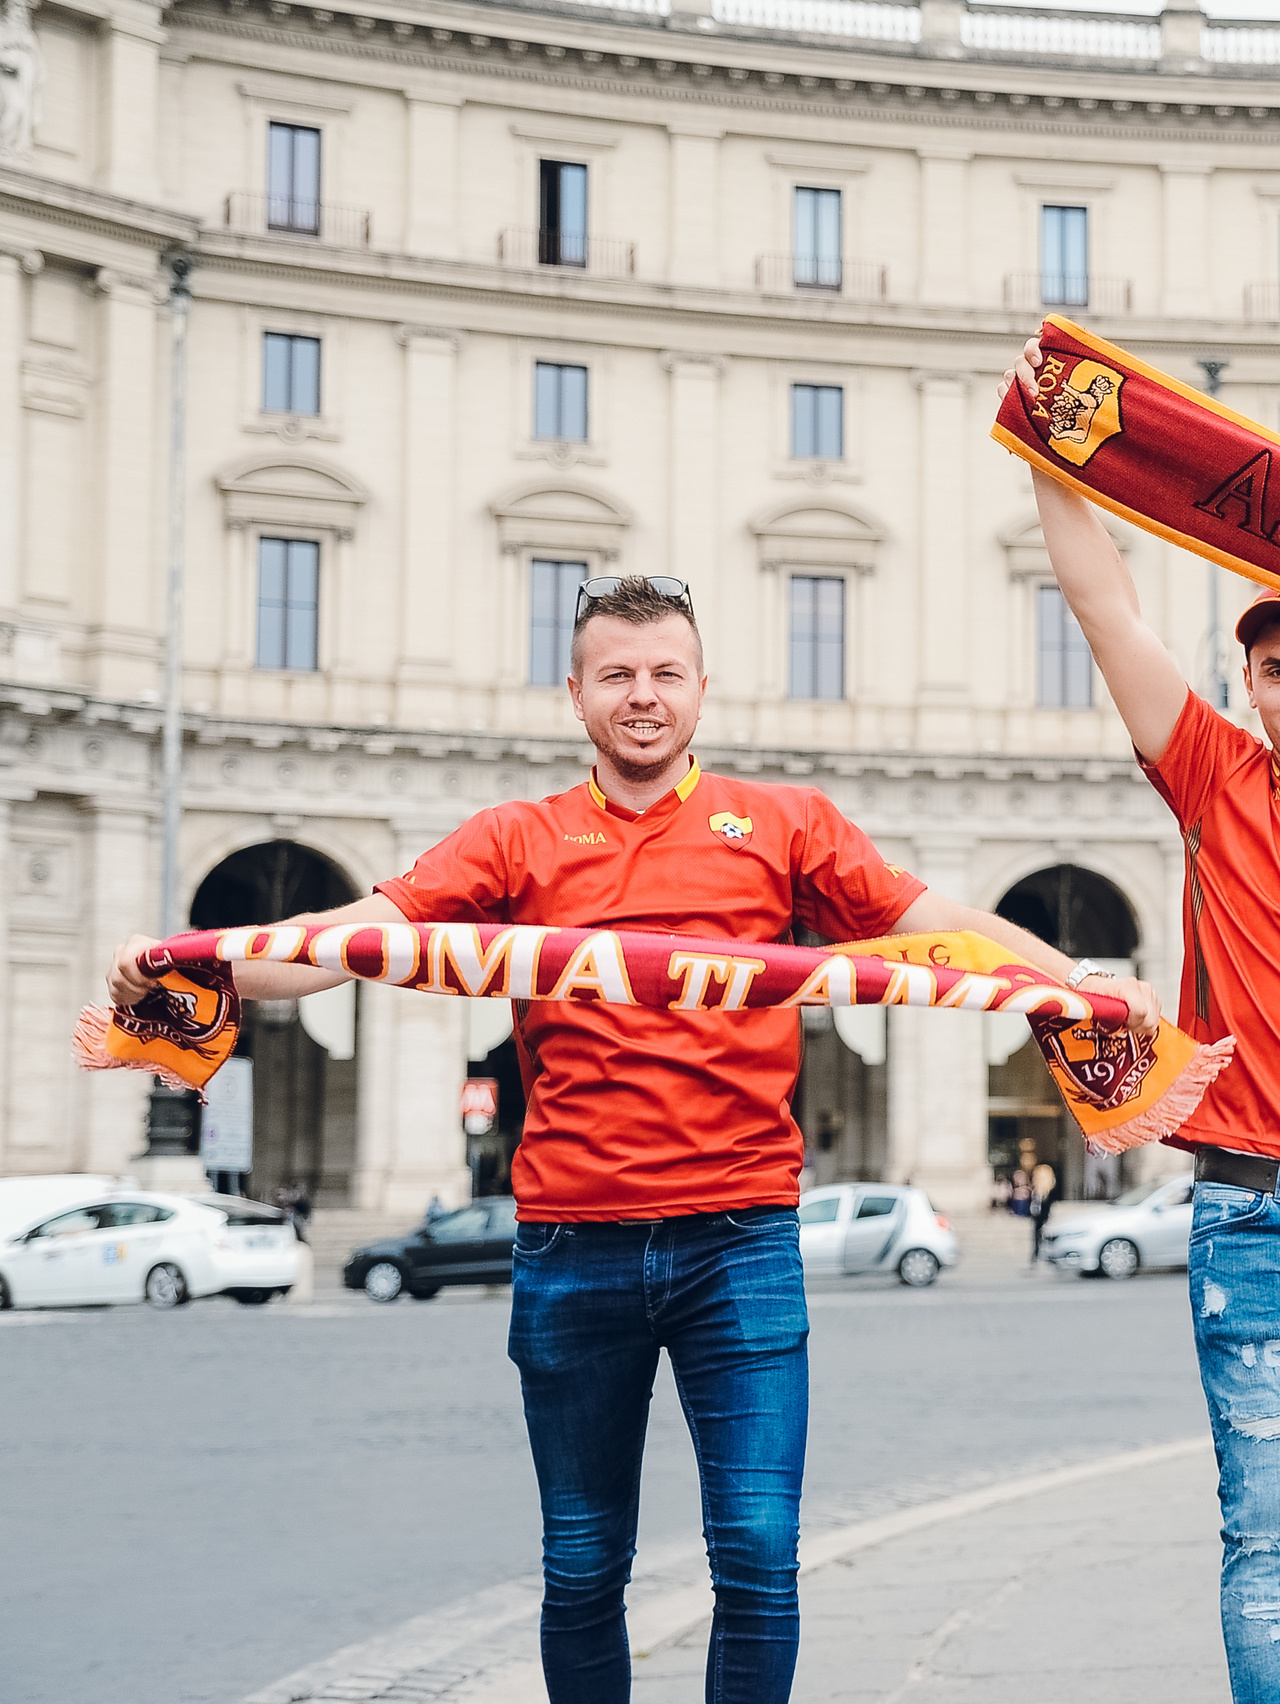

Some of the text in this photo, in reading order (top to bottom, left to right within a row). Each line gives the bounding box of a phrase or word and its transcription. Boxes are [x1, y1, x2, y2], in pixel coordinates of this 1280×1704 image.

[1032, 354, 1066, 418] ROA
[667, 950, 768, 1012] TI
[773, 953, 1094, 1020] AMO
